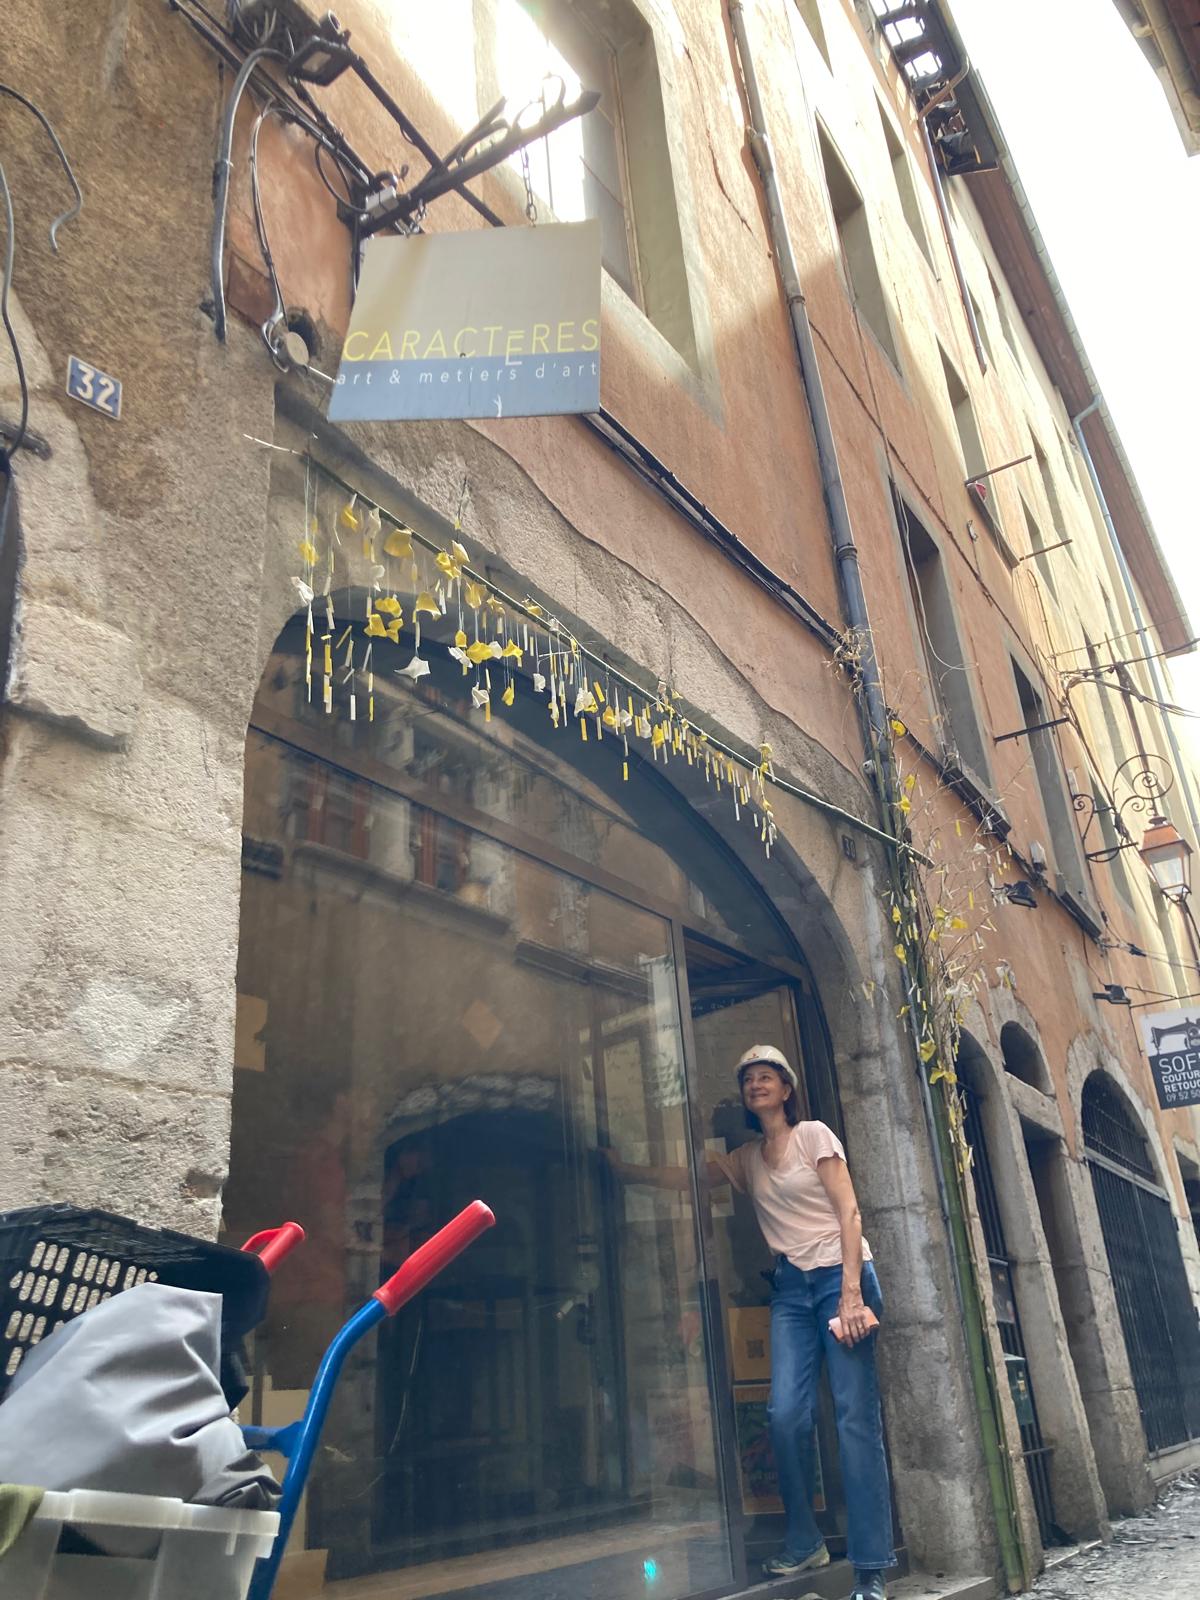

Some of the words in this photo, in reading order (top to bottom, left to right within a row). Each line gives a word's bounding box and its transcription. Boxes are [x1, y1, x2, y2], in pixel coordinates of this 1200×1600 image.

[76, 363, 115, 413] 32
[336, 371, 372, 385] art
[389, 368, 401, 385] &
[419, 367, 517, 383] metiers
[535, 361, 597, 378] d'art
